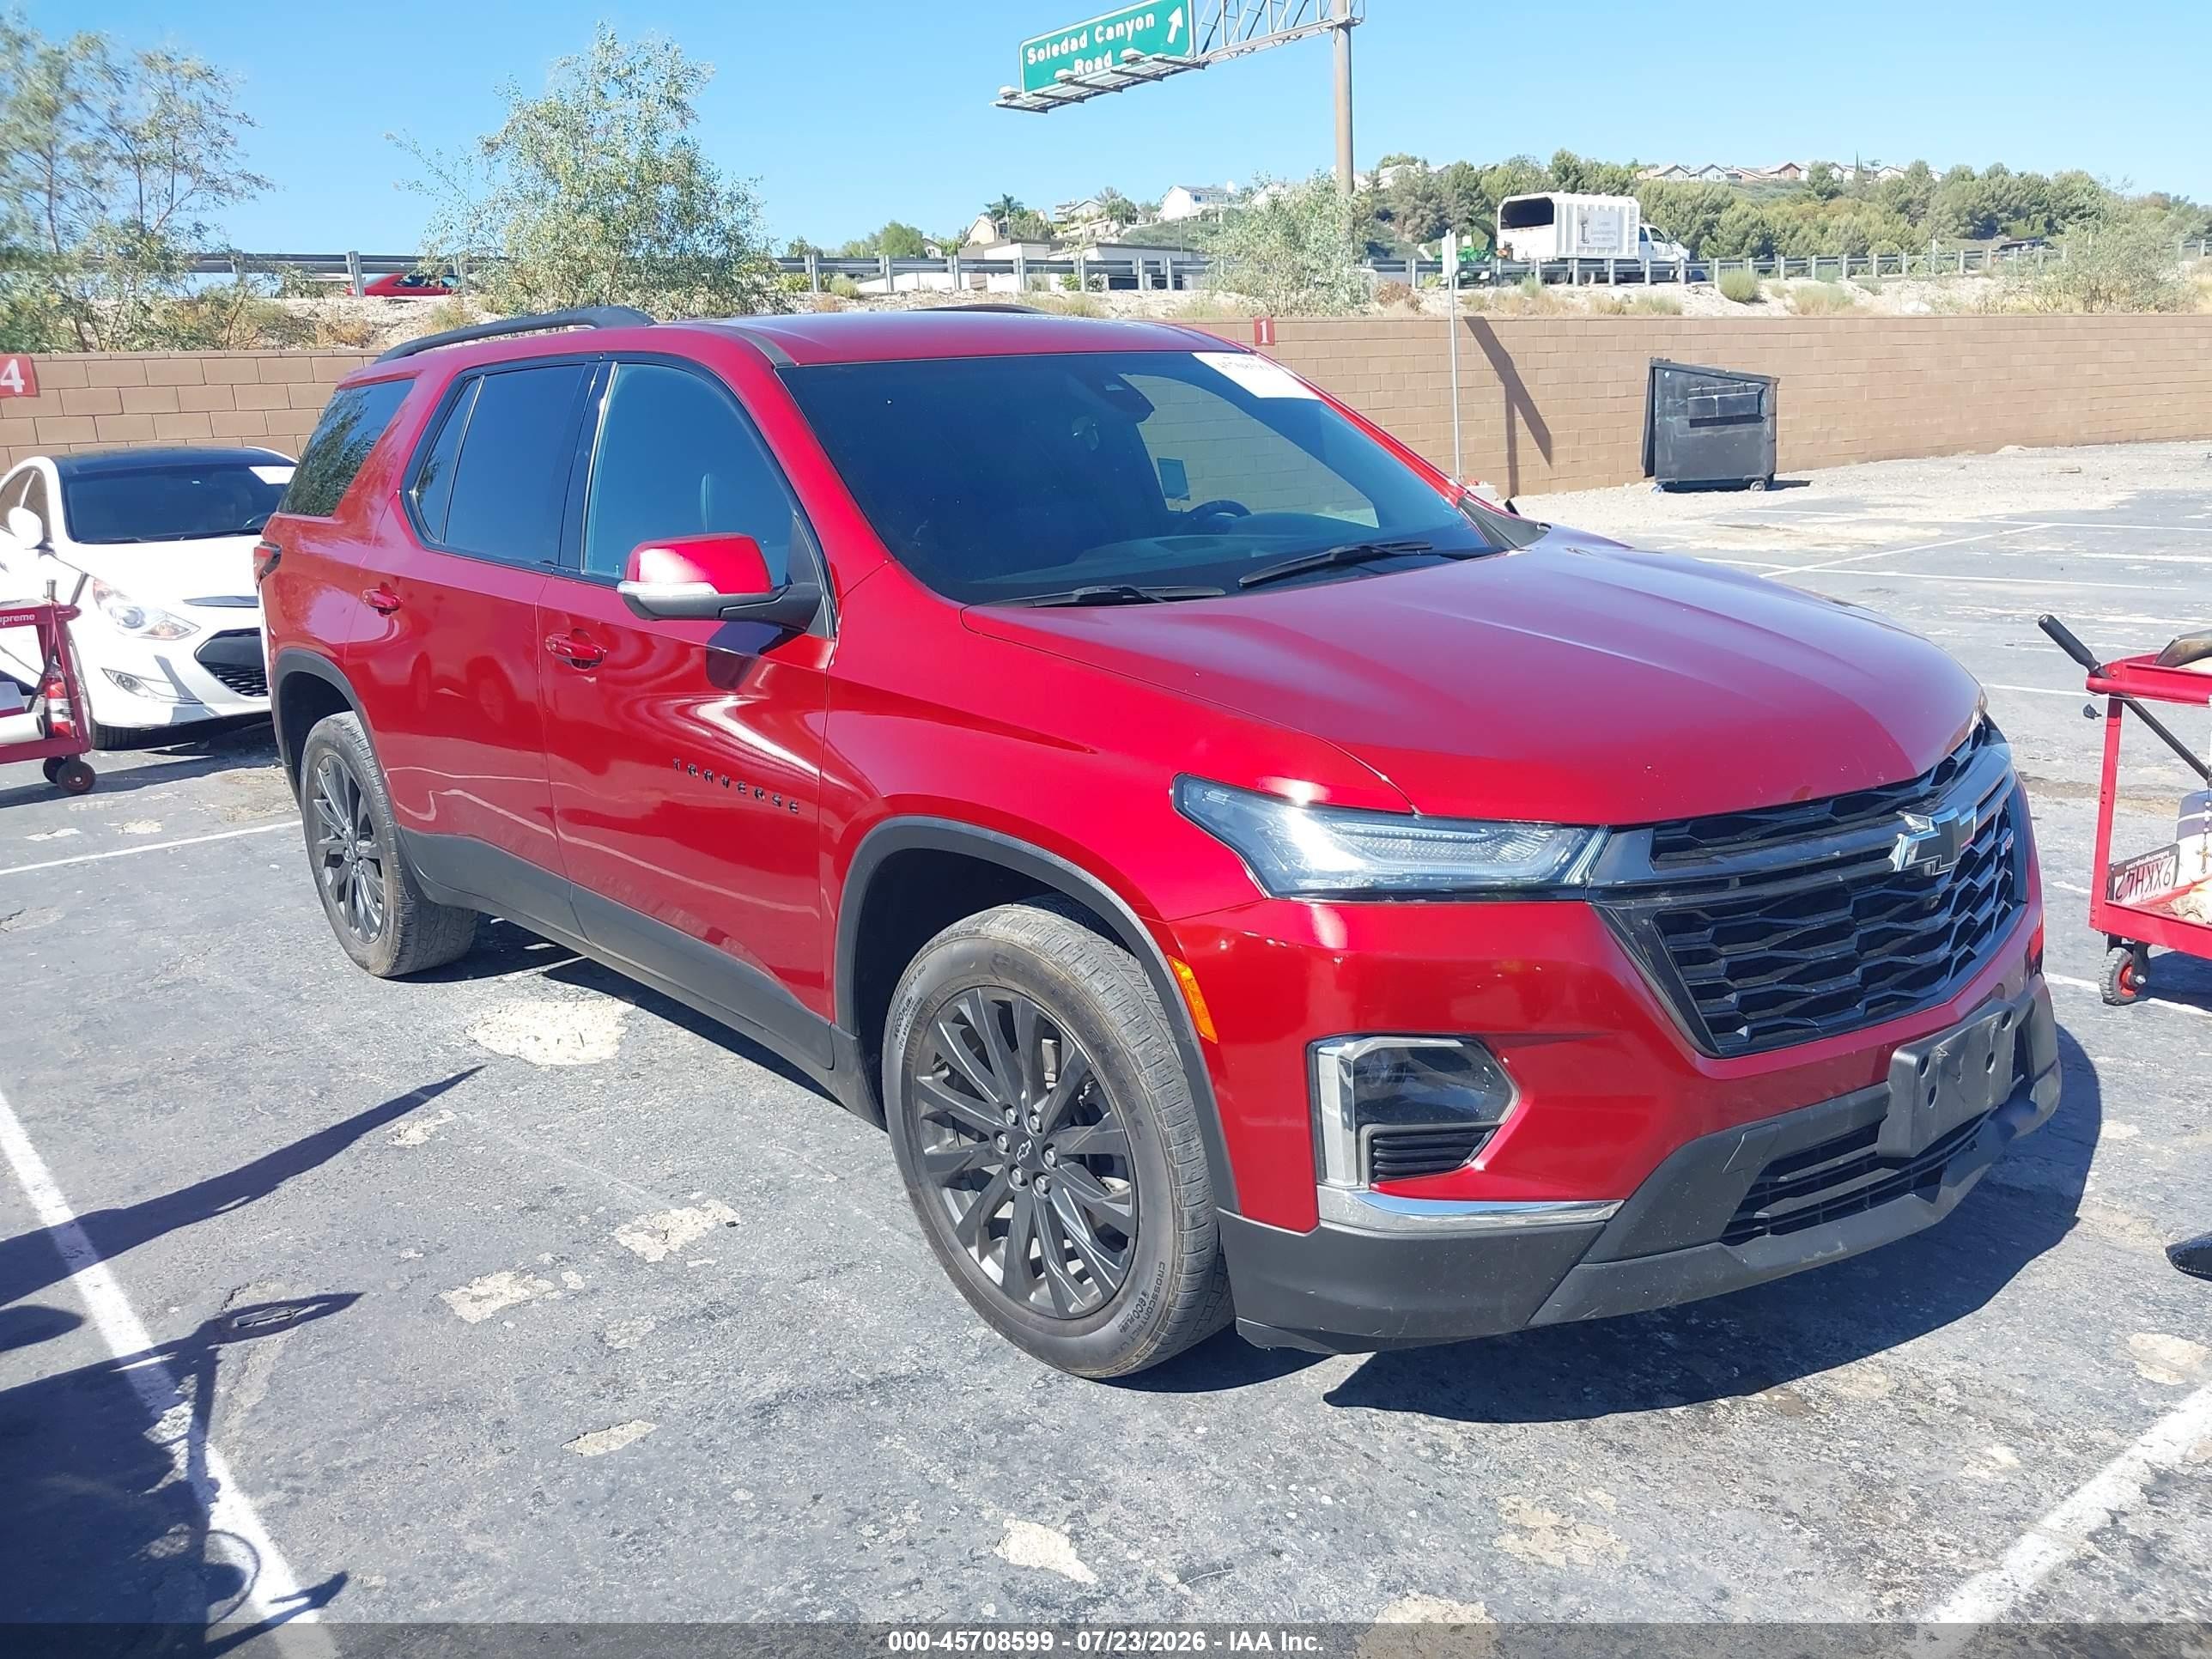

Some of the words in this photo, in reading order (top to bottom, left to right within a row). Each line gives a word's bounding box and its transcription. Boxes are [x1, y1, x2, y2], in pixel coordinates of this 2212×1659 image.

[1027, 30, 1087, 65] Soledad
[1094, 13, 1155, 43] Canyon
[1073, 50, 1113, 76] Road
[1259, 319, 1268, 343] 1
[0, 358, 26, 393] 4
[672, 757, 799, 814] TRAVERSE
